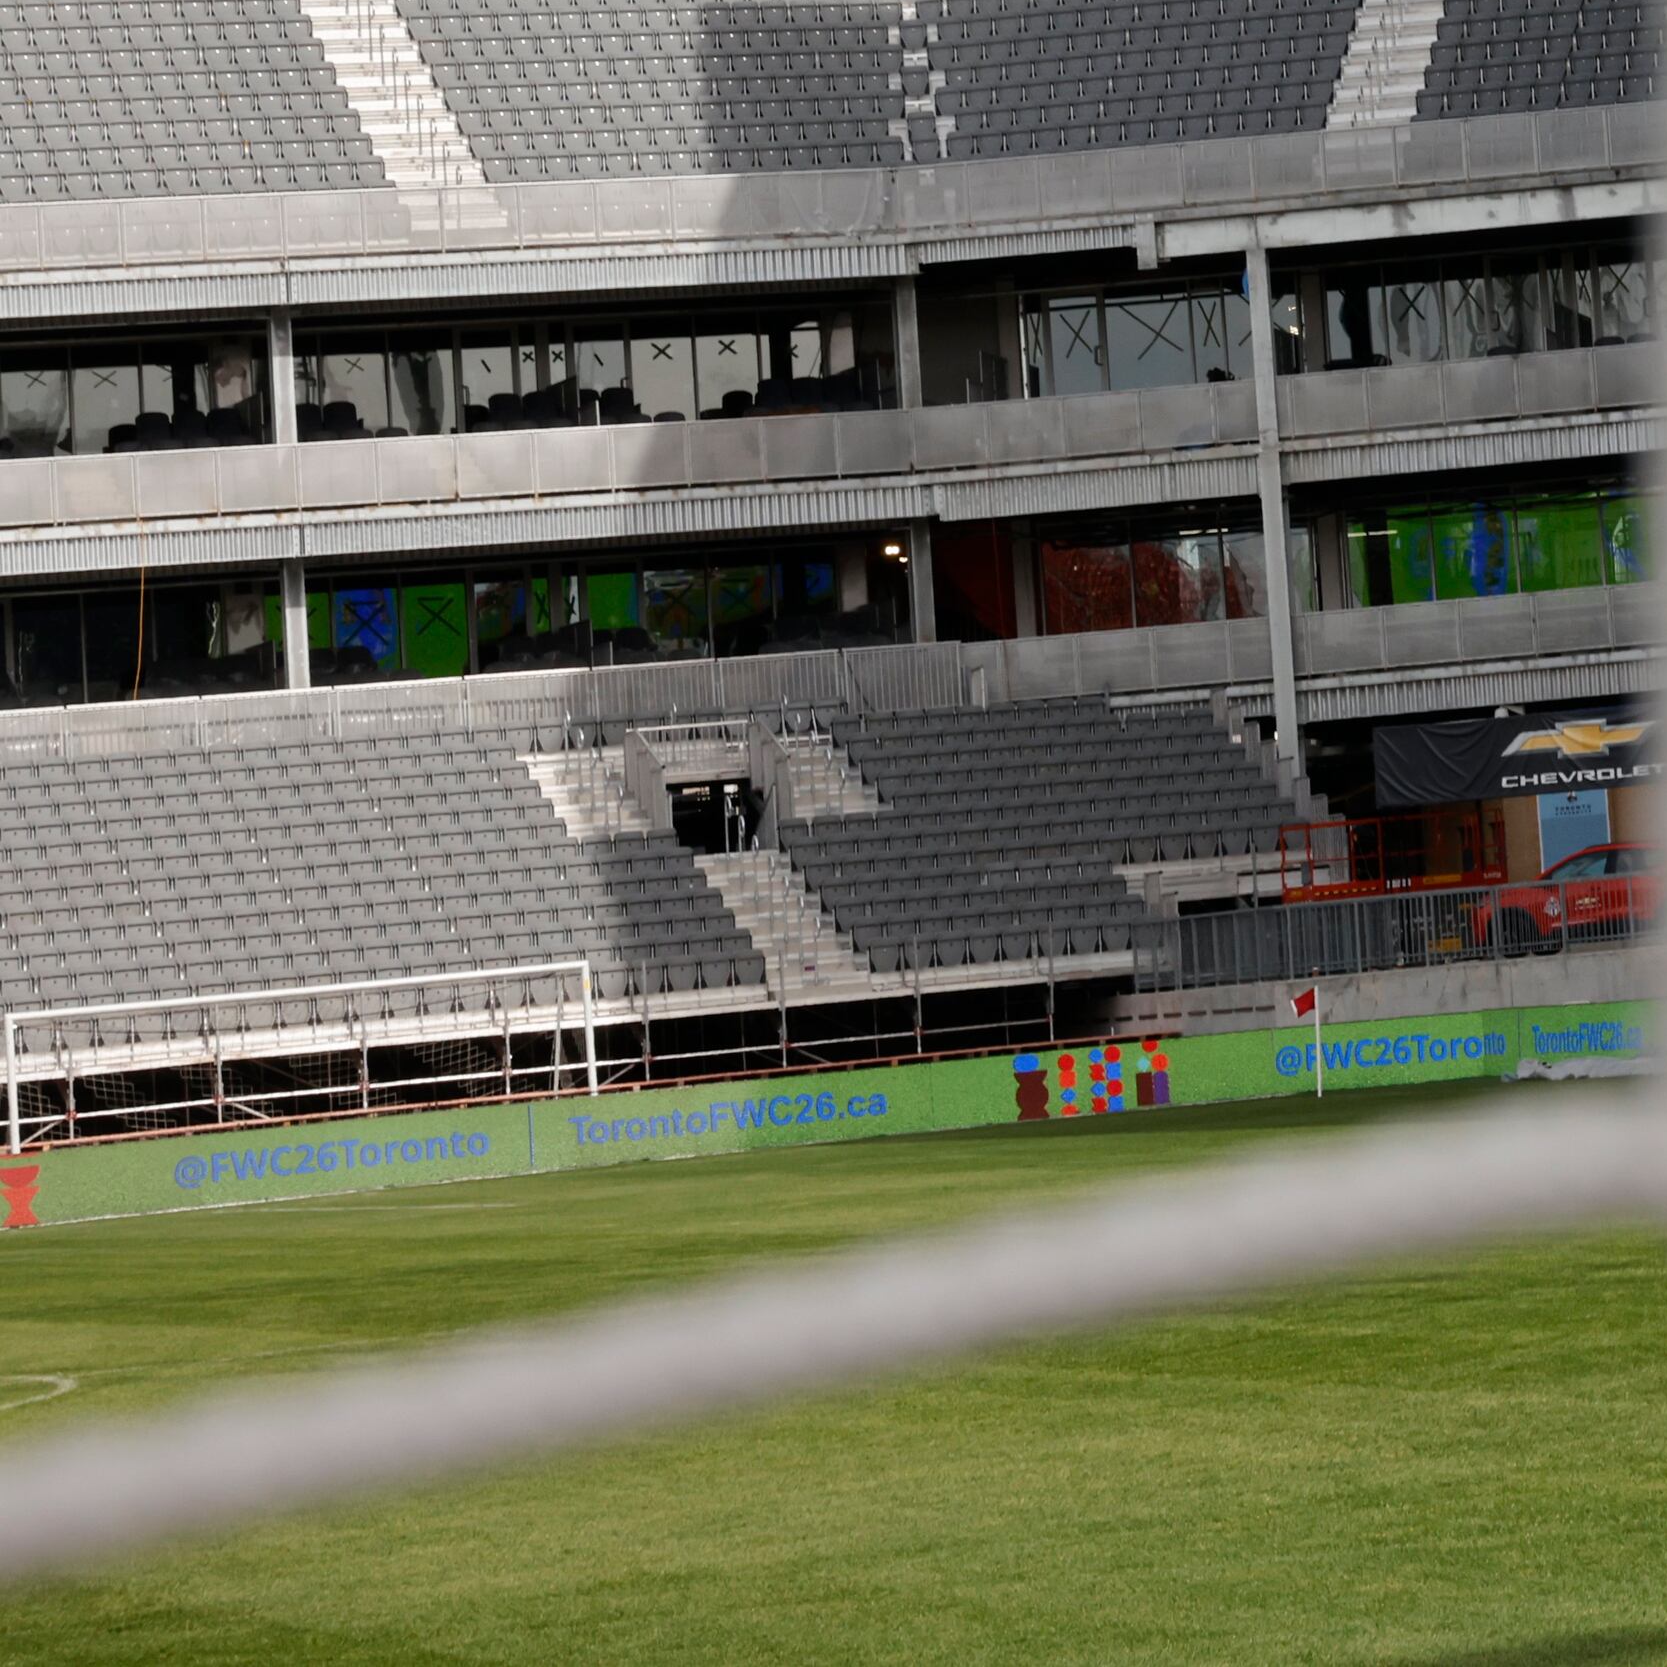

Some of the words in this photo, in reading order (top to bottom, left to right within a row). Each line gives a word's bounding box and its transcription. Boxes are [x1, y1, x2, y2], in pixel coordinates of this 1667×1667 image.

[1501, 762, 1666, 789] CHEVROLET
[1275, 1033, 1507, 1076] @FWC26Toronto
[1532, 1021, 1643, 1054] TorontoFWC26.ca
[569, 1091, 889, 1146] TorontoFWC26.ca
[174, 1131, 490, 1190] @FWC26Toronto
